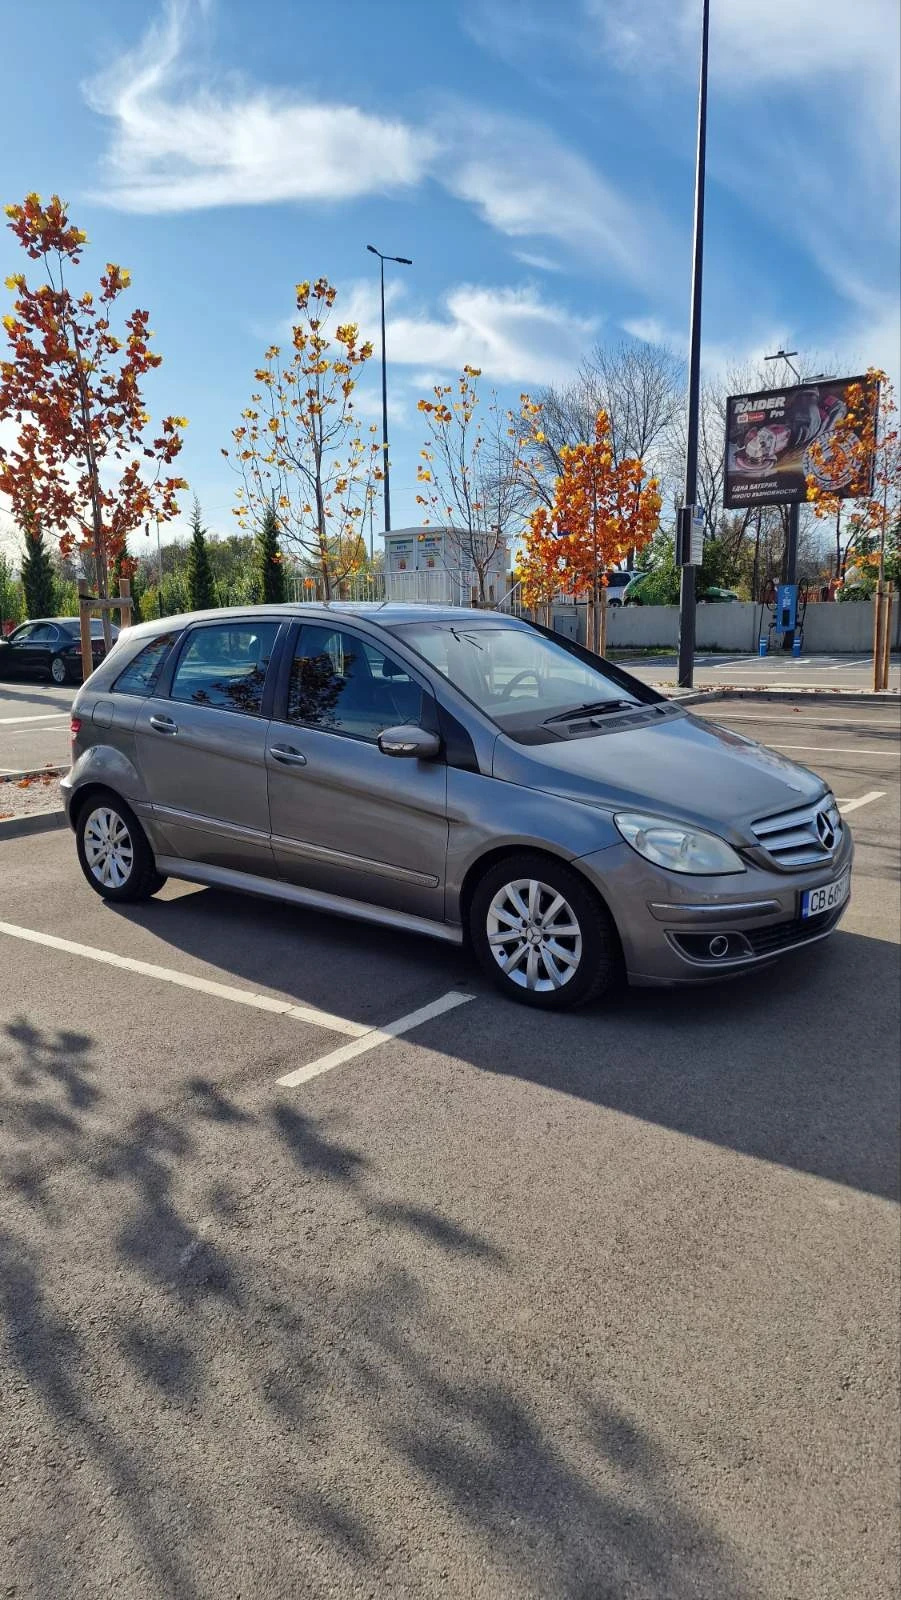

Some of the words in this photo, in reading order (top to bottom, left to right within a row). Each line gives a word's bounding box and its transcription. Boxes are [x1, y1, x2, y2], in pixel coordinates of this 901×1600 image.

[734, 397, 786, 413] RAIDER
[769, 410, 785, 418] Pro
[810, 890, 826, 911] CB
